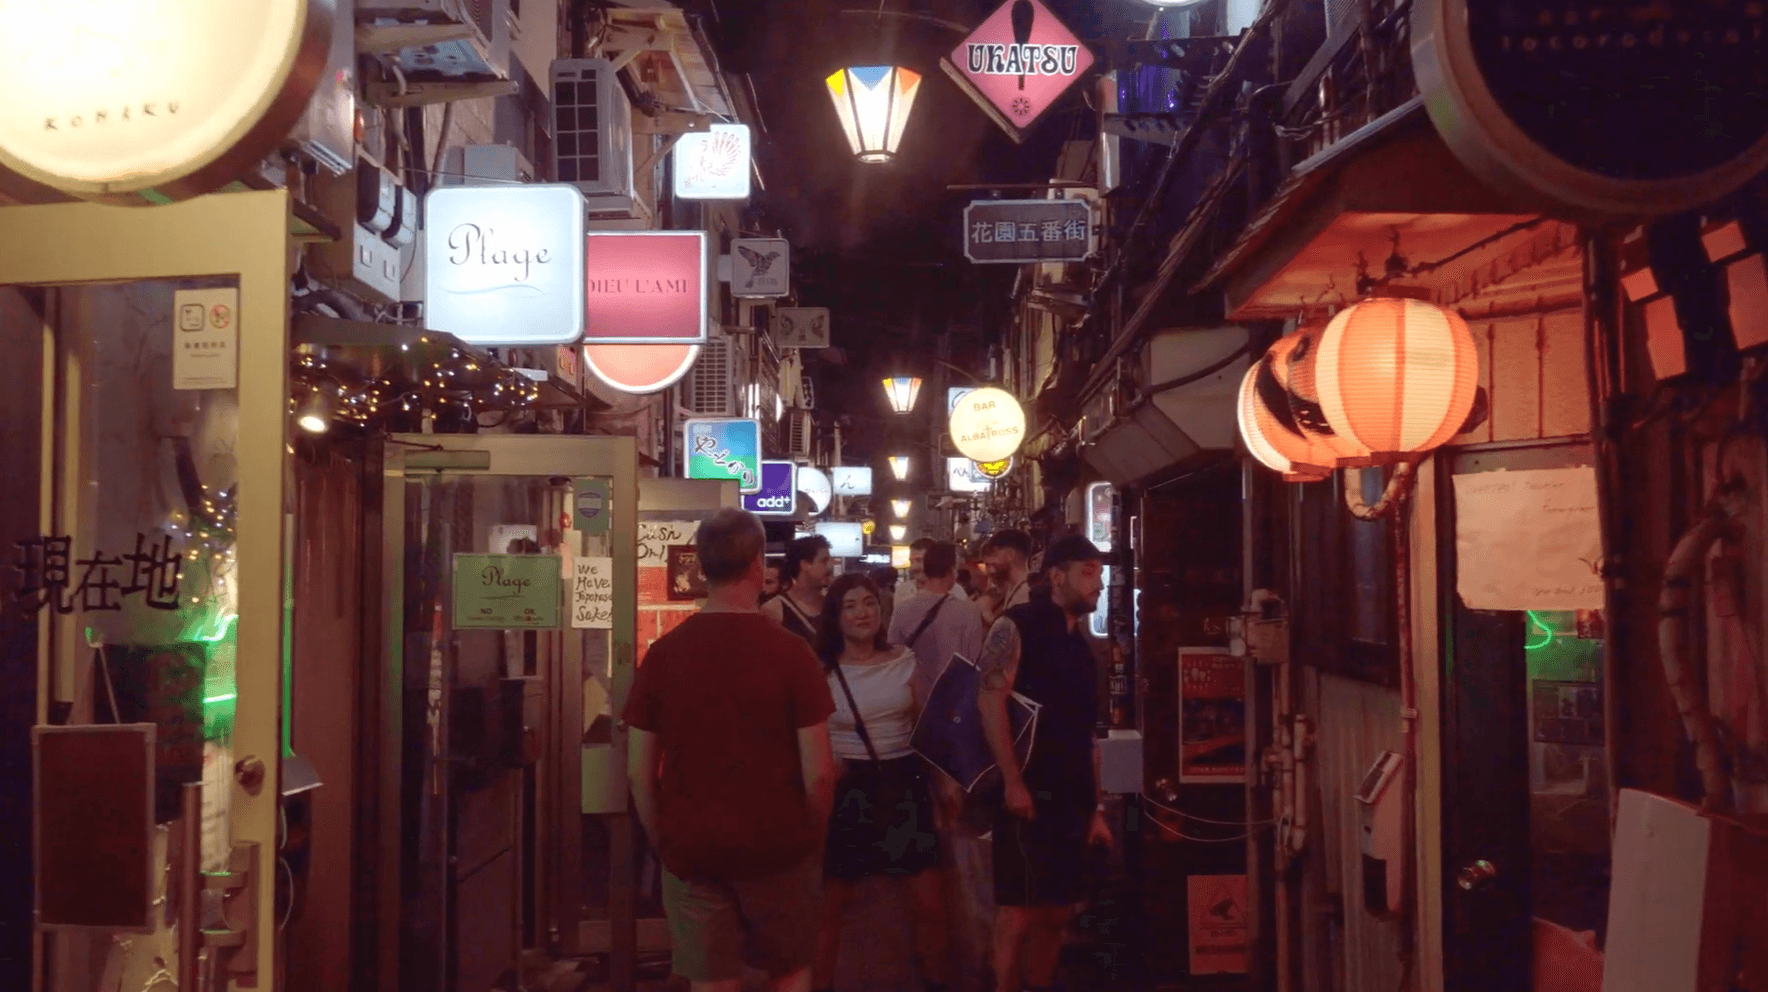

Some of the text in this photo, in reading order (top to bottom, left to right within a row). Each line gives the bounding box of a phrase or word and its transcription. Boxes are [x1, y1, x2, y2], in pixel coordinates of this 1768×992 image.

[966, 42, 1081, 76] UKATSU
[971, 219, 1087, 244] 花園五番街
[448, 223, 552, 283] Plage
[973, 400, 996, 412] BAR
[960, 425, 1019, 443] ALBATROSS
[756, 494, 792, 508] add+
[13, 532, 182, 614] 現在地
[481, 565, 532, 593] Plage
